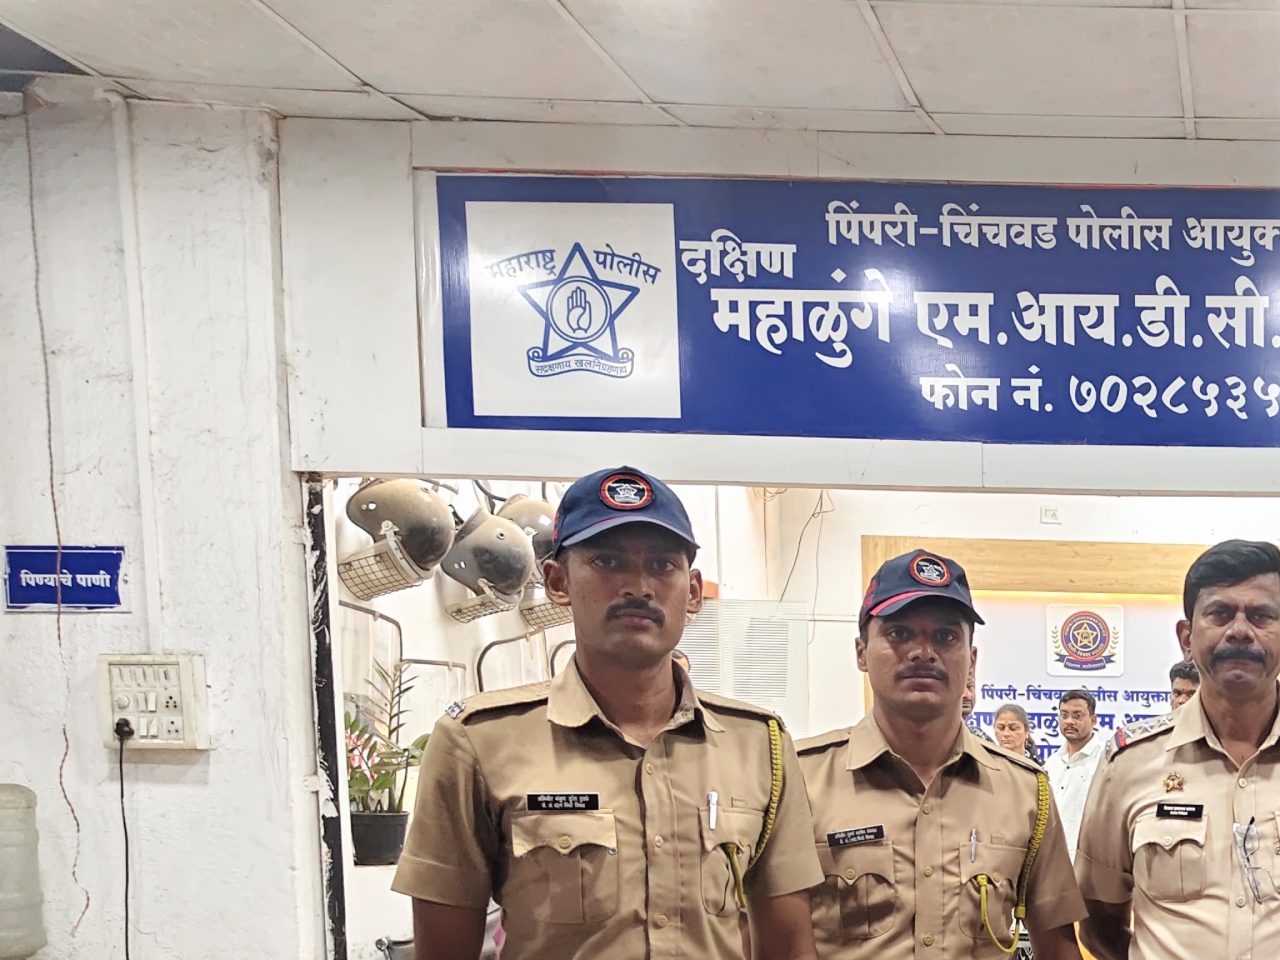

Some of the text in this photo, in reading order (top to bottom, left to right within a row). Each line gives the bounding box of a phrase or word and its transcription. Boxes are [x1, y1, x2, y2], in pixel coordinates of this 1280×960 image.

[826, 200, 1058, 250] पिंपरी-चिंचवड
[1067, 203, 1172, 252] पोलीस
[593, 243, 662, 285] पोलीस
[678, 228, 797, 284] दक्षिण
[710, 268, 891, 369] महाळुंगे
[920, 362, 1000, 413] फोन
[1011, 362, 1054, 413] नं.
[20, 568, 111, 588] पिण्याचे पाणी
